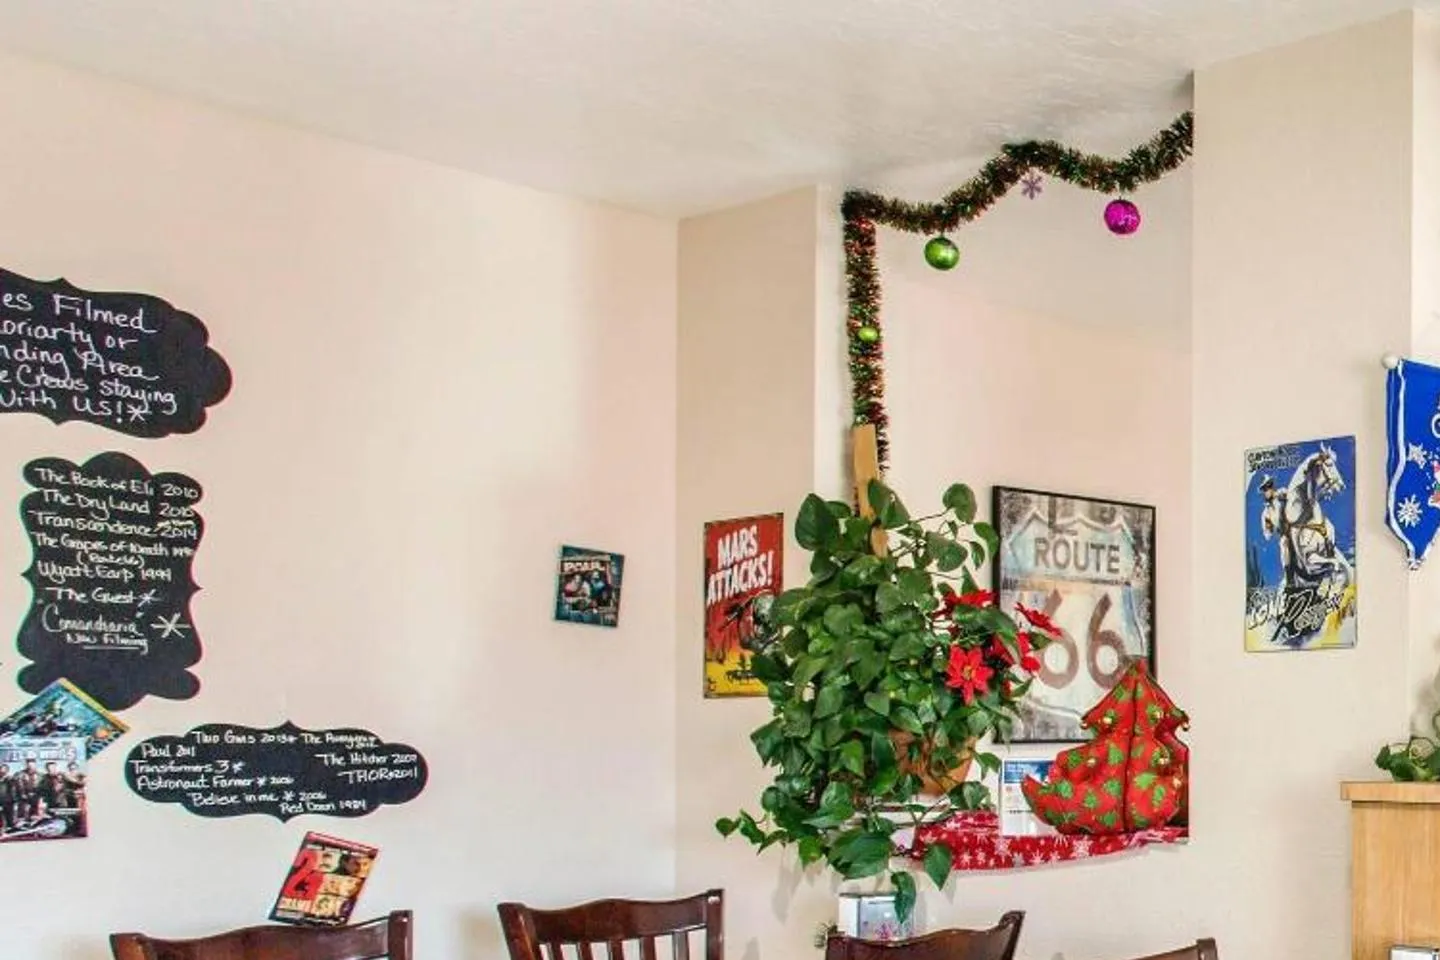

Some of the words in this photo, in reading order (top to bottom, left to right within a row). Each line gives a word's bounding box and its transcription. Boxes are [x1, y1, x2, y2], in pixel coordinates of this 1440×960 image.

[53, 293, 158, 334] Filmed
[0, 318, 96, 355] oriarty
[105, 335, 139, 349] or
[34, 468, 69, 486] The
[71, 471, 110, 489] Book
[161, 483, 199, 499] 2010
[38, 487, 74, 507] The
[75, 493, 110, 521] Dry
[109, 495, 150, 514] Land
[717, 524, 758, 570] MARS
[1034, 537, 1120, 573] ROUTE
[37, 560, 95, 584] Wyatt
[96, 565, 134, 583] Earp
[706, 550, 775, 607] ATTACKS!
[45, 587, 88, 603] The
[91, 587, 135, 603] Guest
[1039, 588, 1127, 690] 66
[140, 742, 171, 759] Paul
[191, 731, 218, 745] Two
[215, 760, 230, 774] 3
[314, 753, 346, 767] The
[136, 774, 210, 790] Astronaut
